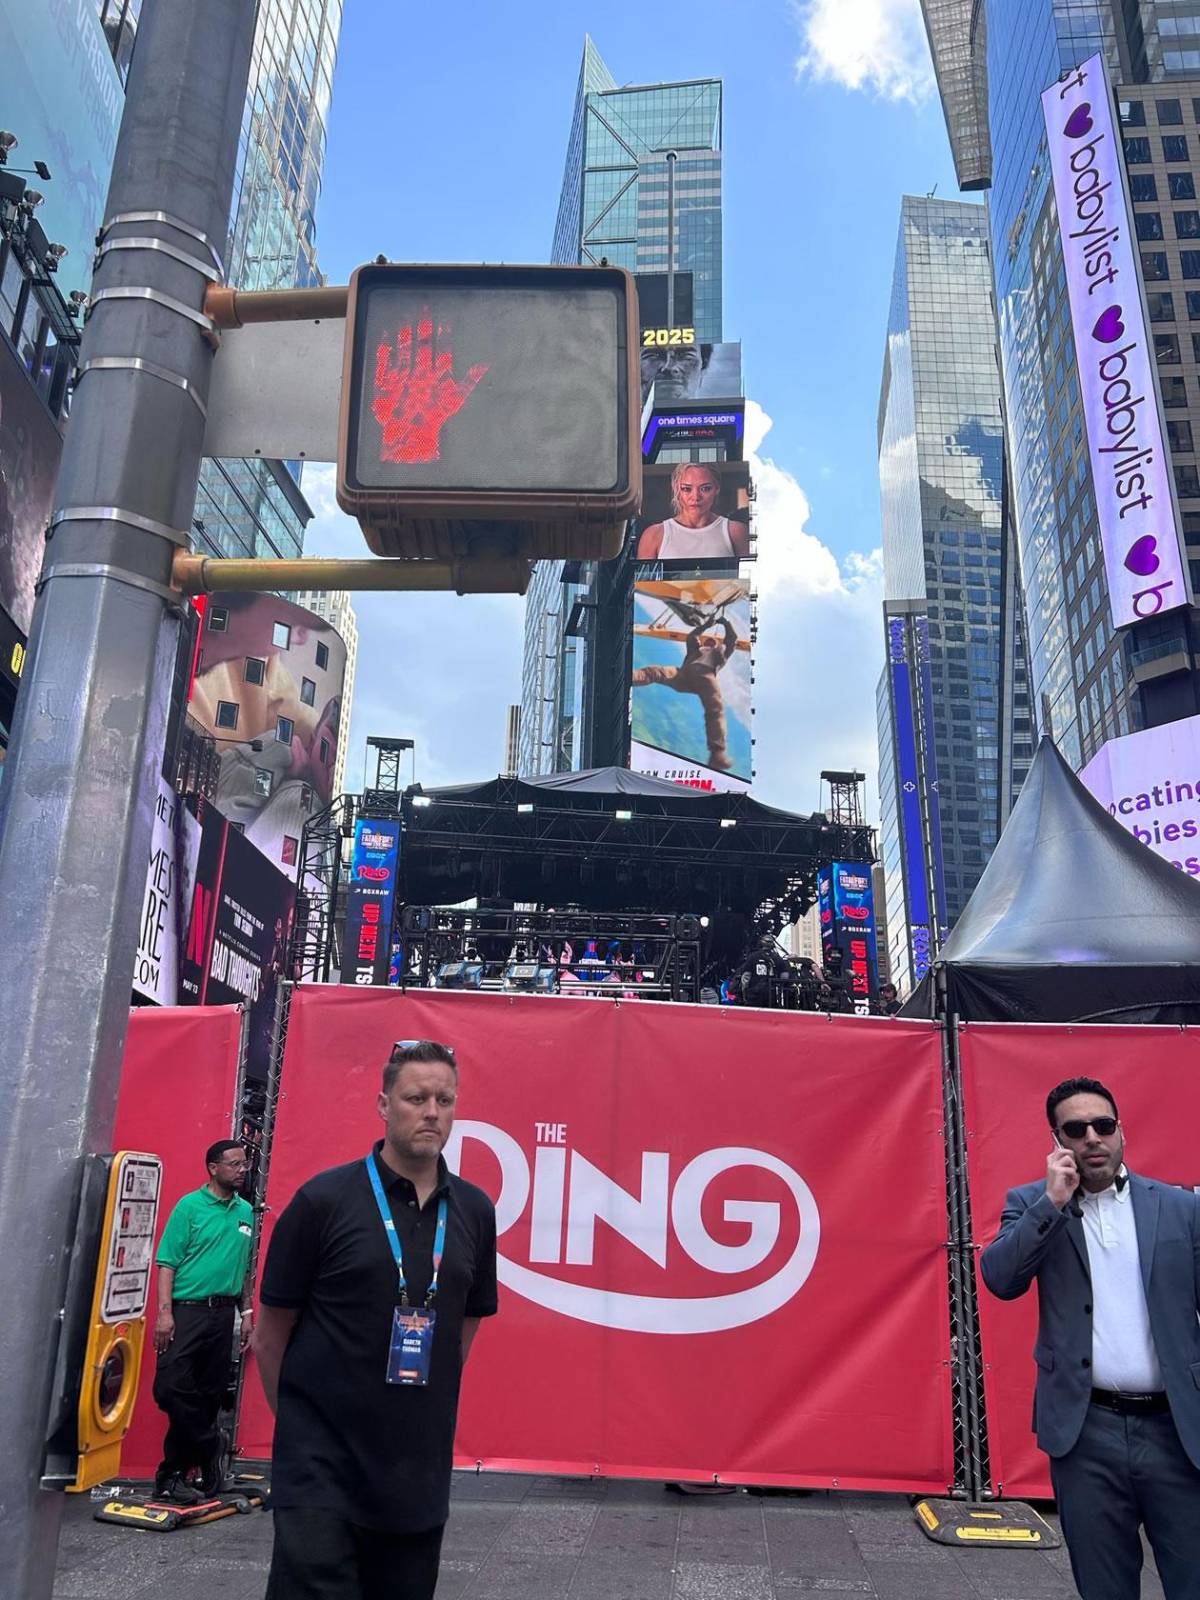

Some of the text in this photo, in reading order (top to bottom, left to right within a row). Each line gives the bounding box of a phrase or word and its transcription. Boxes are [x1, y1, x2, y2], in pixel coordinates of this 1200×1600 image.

[1069, 133, 1120, 296] babylist
[643, 328, 695, 346] 2025
[658, 415, 736, 426] one times square
[1098, 342, 1154, 519] babylist
[664, 769, 702, 779] CRUISE
[358, 903, 380, 961] UP NEXT
[210, 939, 262, 1003] BAD THOUGHTS
[534, 1122, 567, 1144] THE
